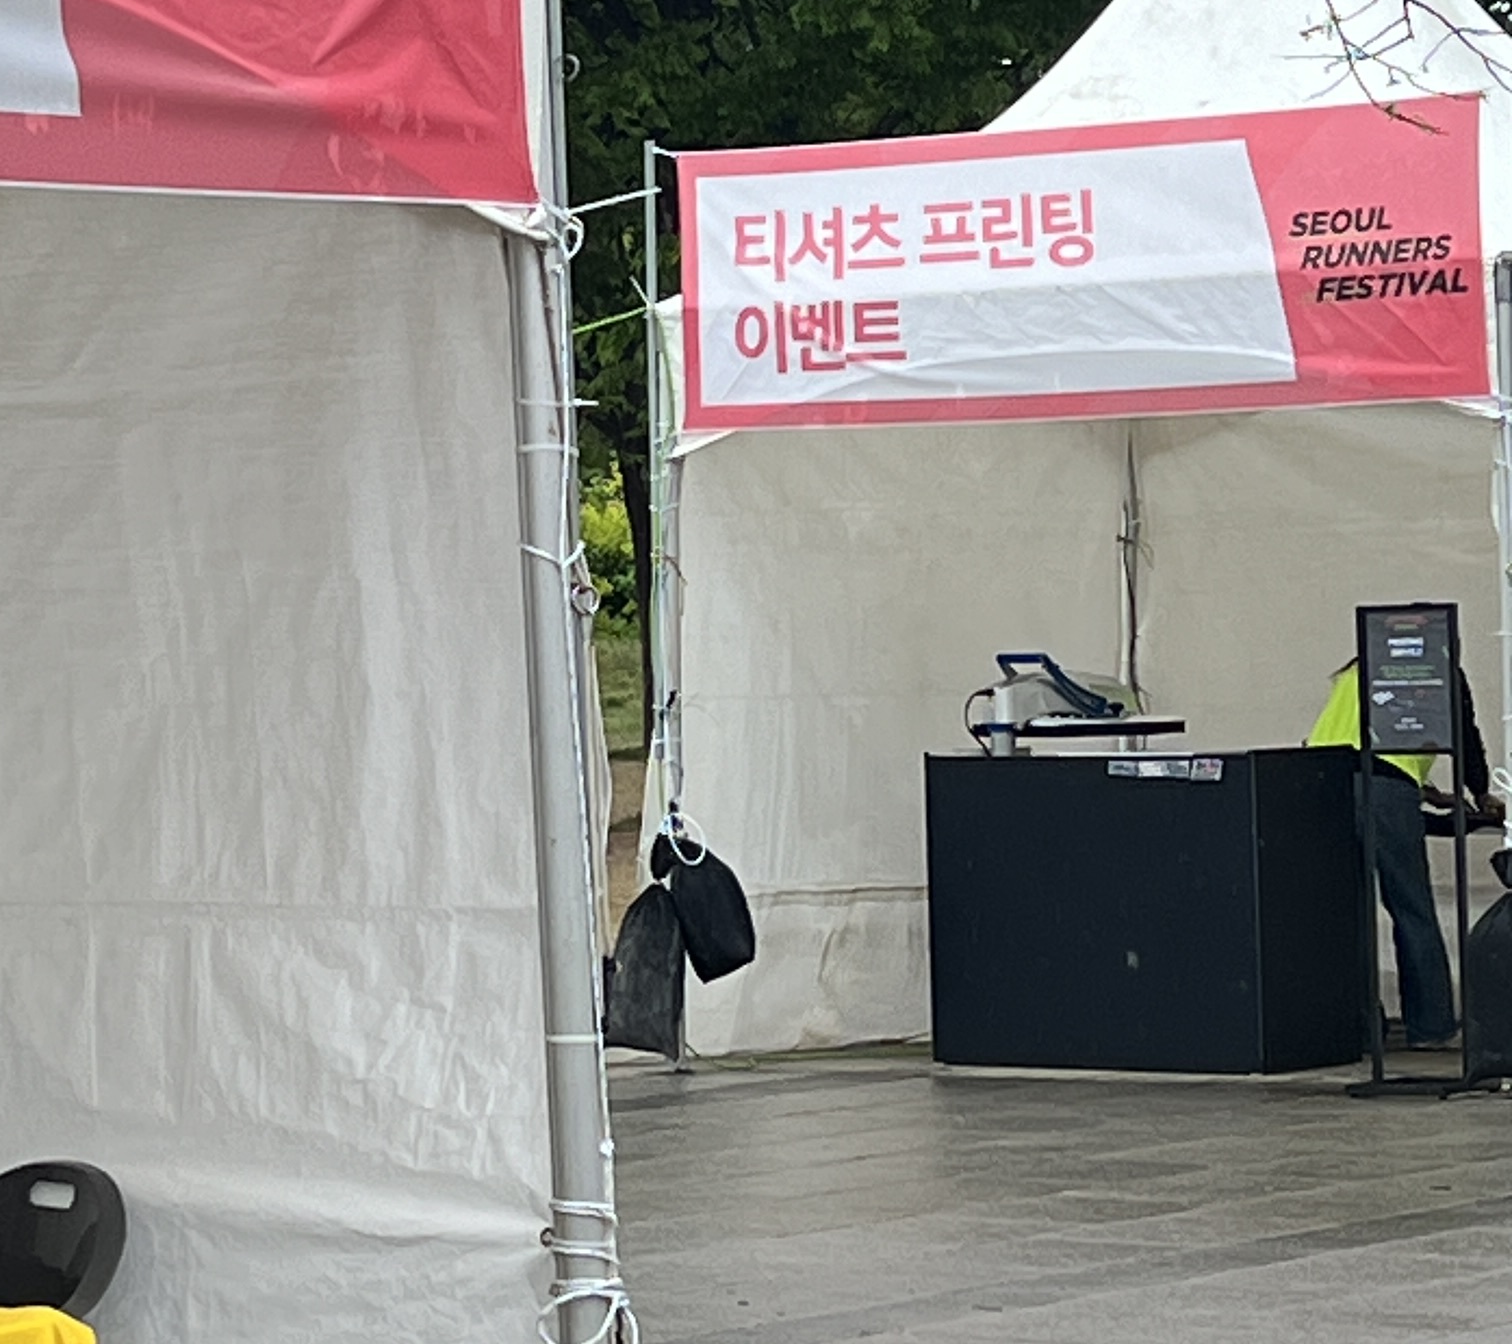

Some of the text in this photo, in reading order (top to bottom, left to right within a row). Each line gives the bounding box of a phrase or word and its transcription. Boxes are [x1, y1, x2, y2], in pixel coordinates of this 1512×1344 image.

[734, 189, 1095, 282] 티셔츠 프린팅
[1289, 205, 1393, 237] SEOUL
[1300, 234, 1452, 271] RUNNERS
[1315, 267, 1469, 304] FESTIVAL
[734, 299, 907, 374] 이벤트
